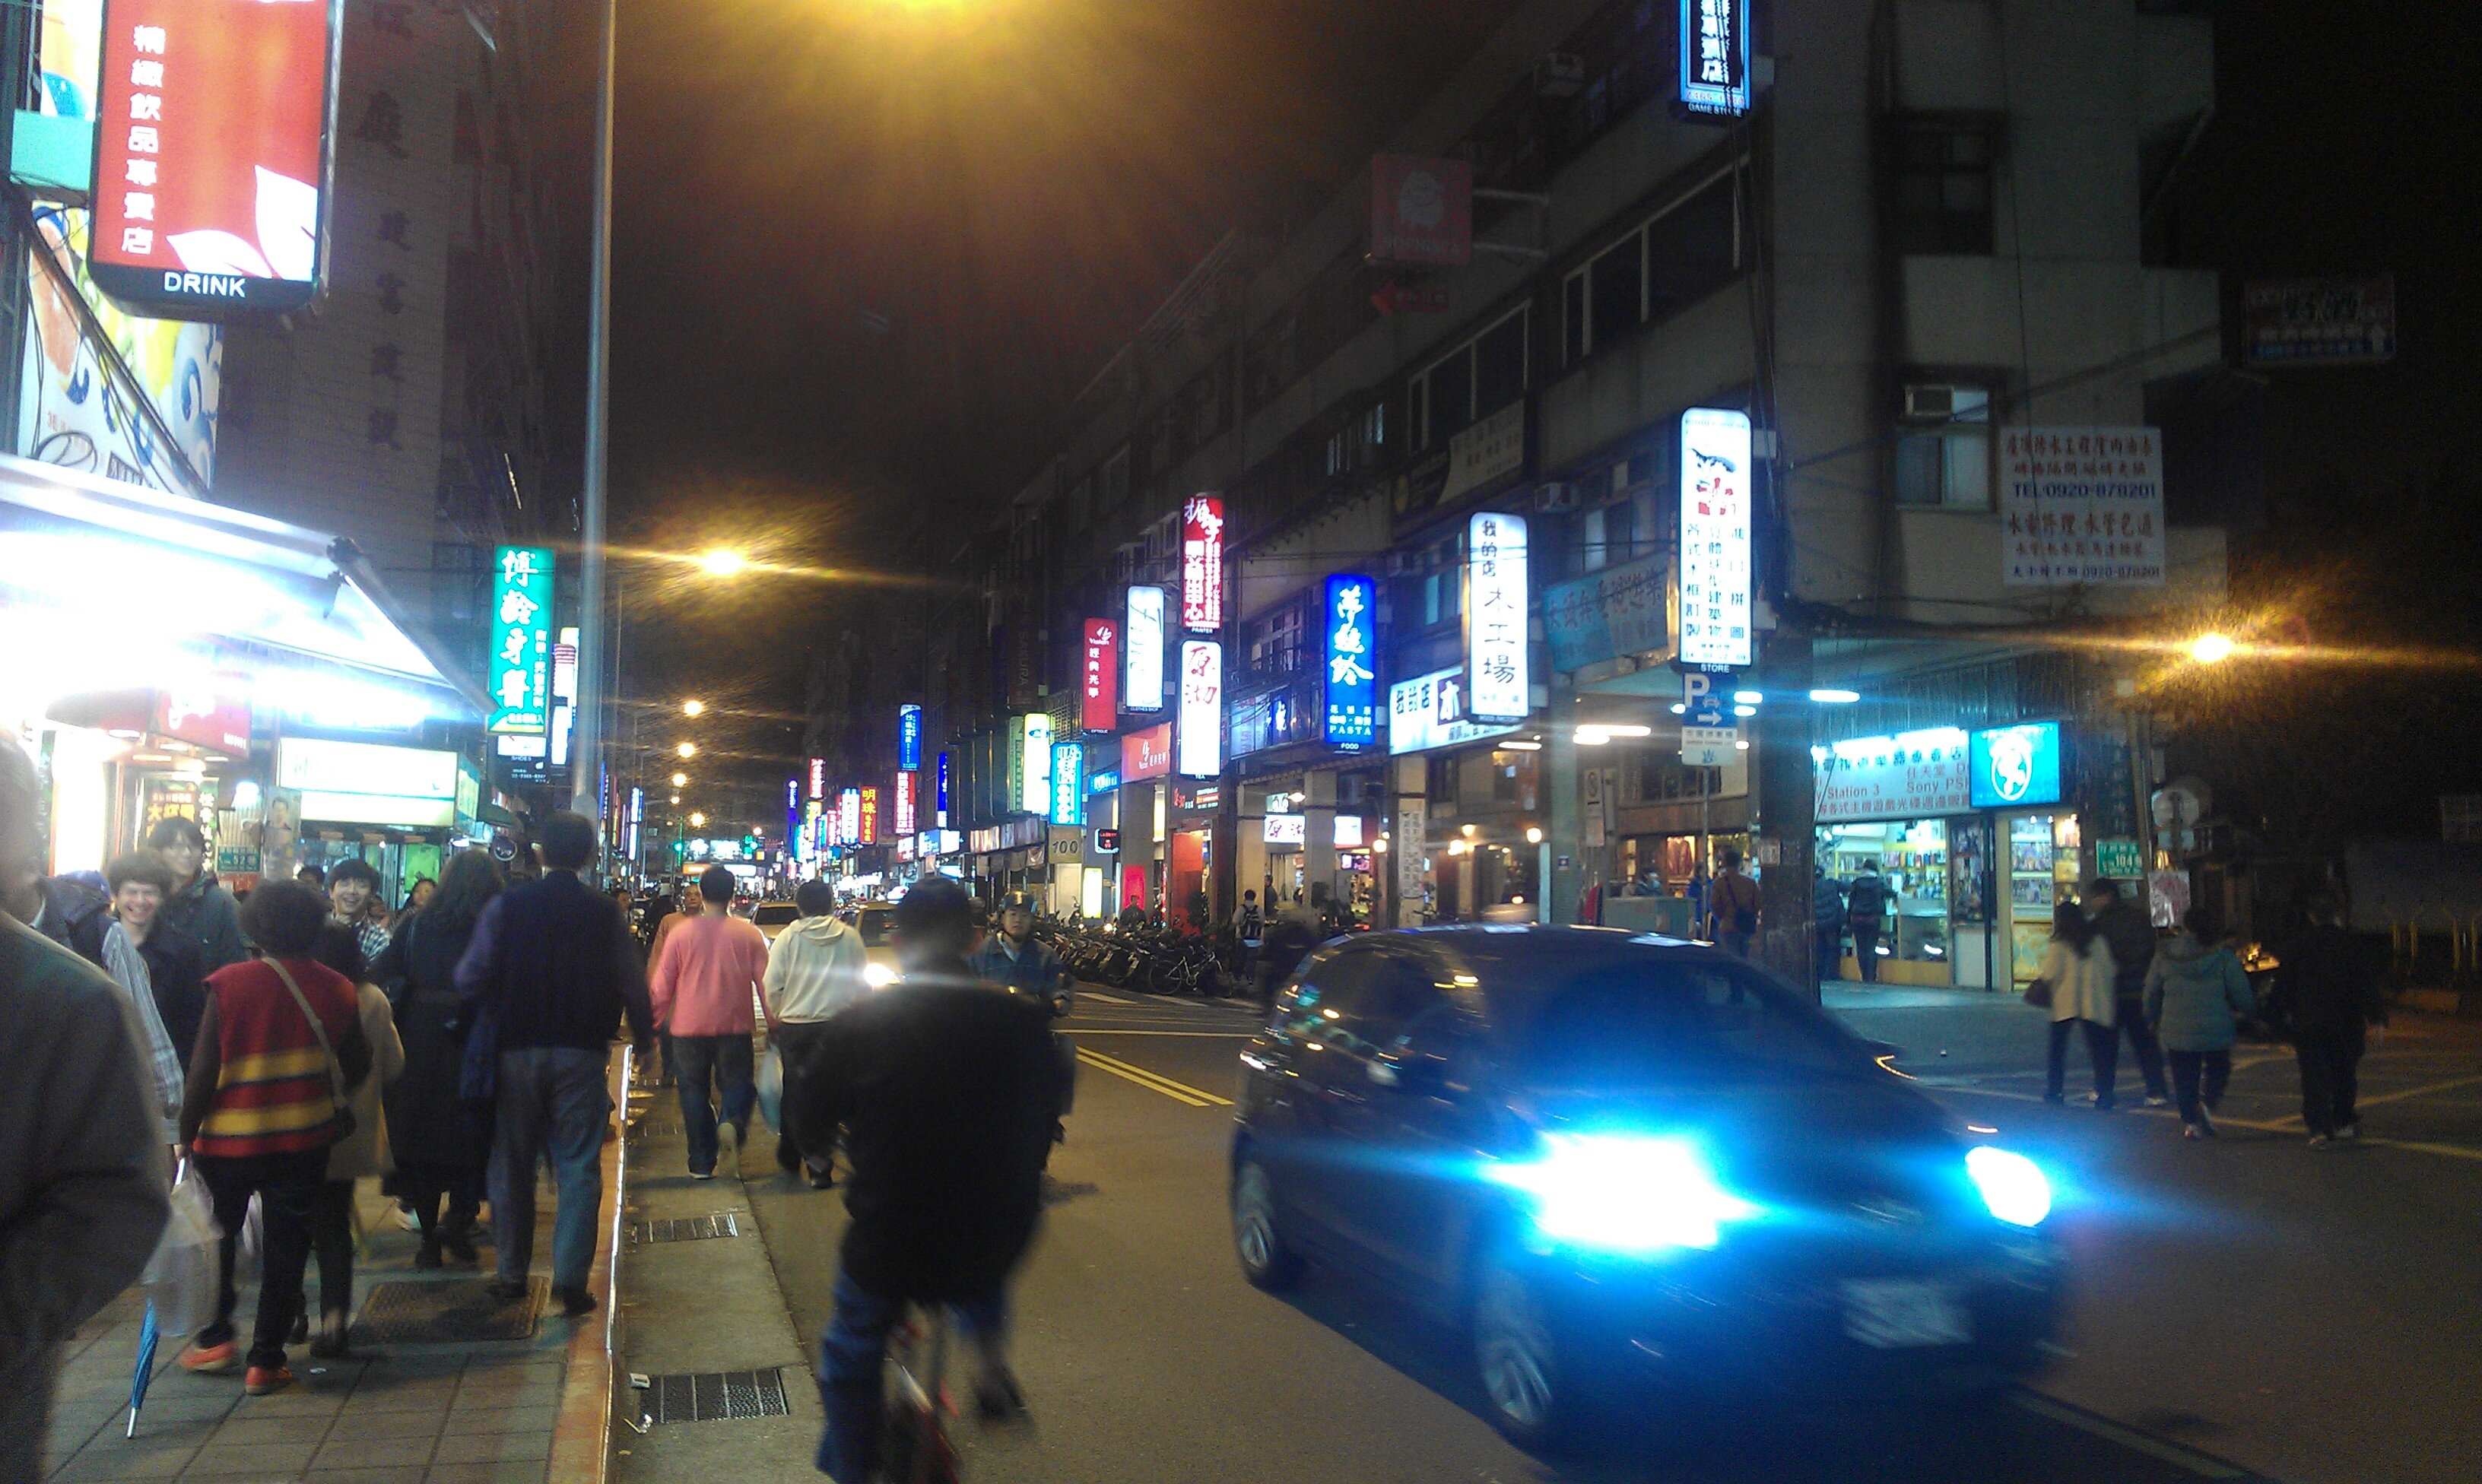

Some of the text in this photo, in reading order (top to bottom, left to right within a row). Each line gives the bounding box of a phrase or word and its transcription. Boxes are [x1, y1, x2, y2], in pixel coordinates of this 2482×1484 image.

[121, 24, 166, 255] 精緻飲品專賣店
[164, 271, 246, 297] DRINK
[1481, 519, 1497, 578] 我的店
[497, 550, 539, 710] 博齡牙醫
[1484, 587, 1516, 684] 木工場
[1088, 648, 1100, 699] 經典光學
[1700, 663, 1730, 674] STORE
[1684, 673, 1711, 708] P
[1329, 725, 1371, 736] PASTA
[862, 788, 876, 814] 明珠
[1827, 786, 1868, 801] Station
[1906, 779, 1938, 799] Sony
[1052, 840, 1078, 854] 100
